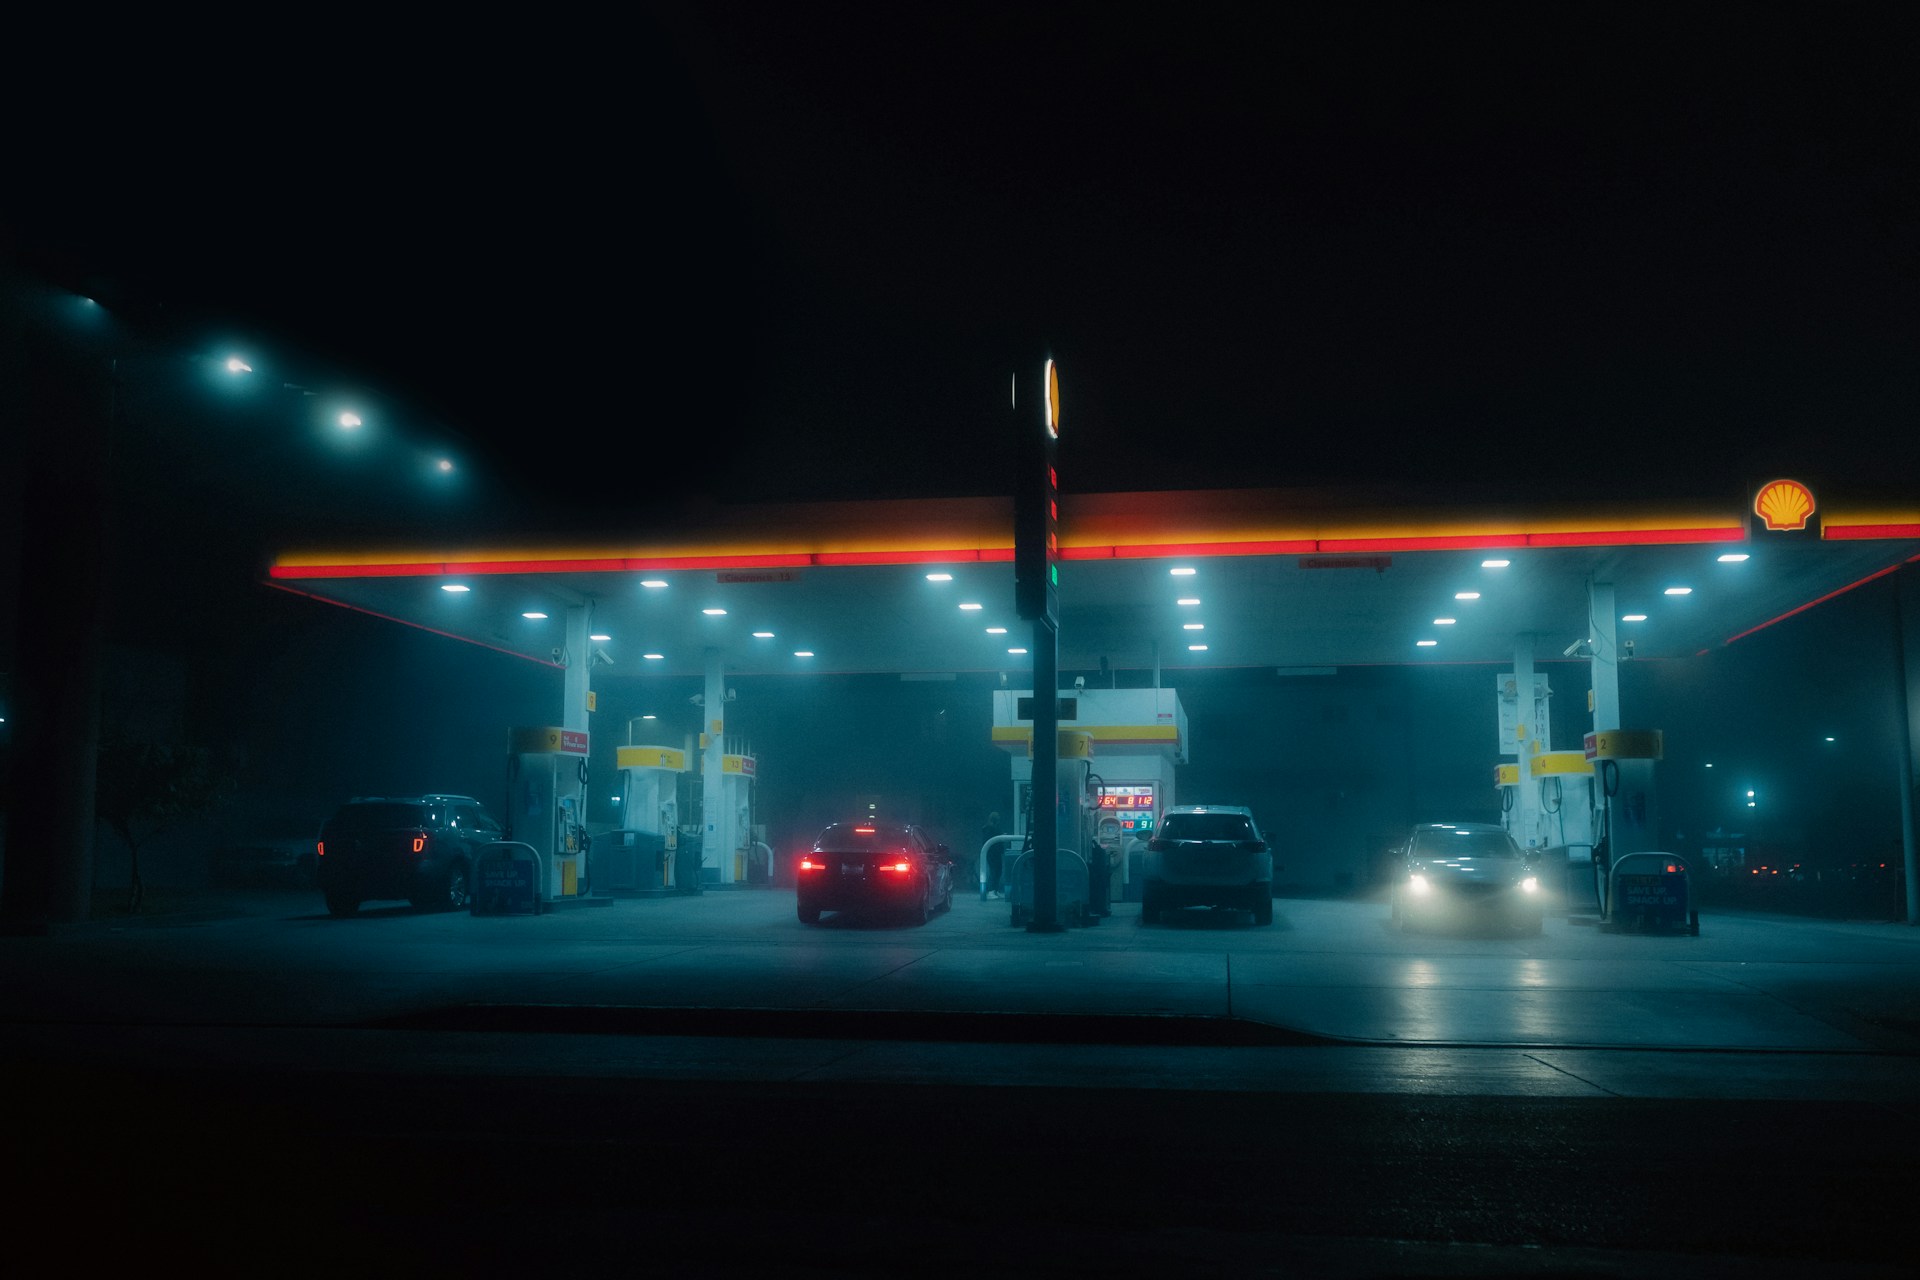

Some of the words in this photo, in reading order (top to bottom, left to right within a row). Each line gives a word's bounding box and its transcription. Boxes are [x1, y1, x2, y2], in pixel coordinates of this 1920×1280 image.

[550, 734, 557, 745] 9
[1600, 738, 1607, 750] 2
[1079, 740, 1085, 751] 7
